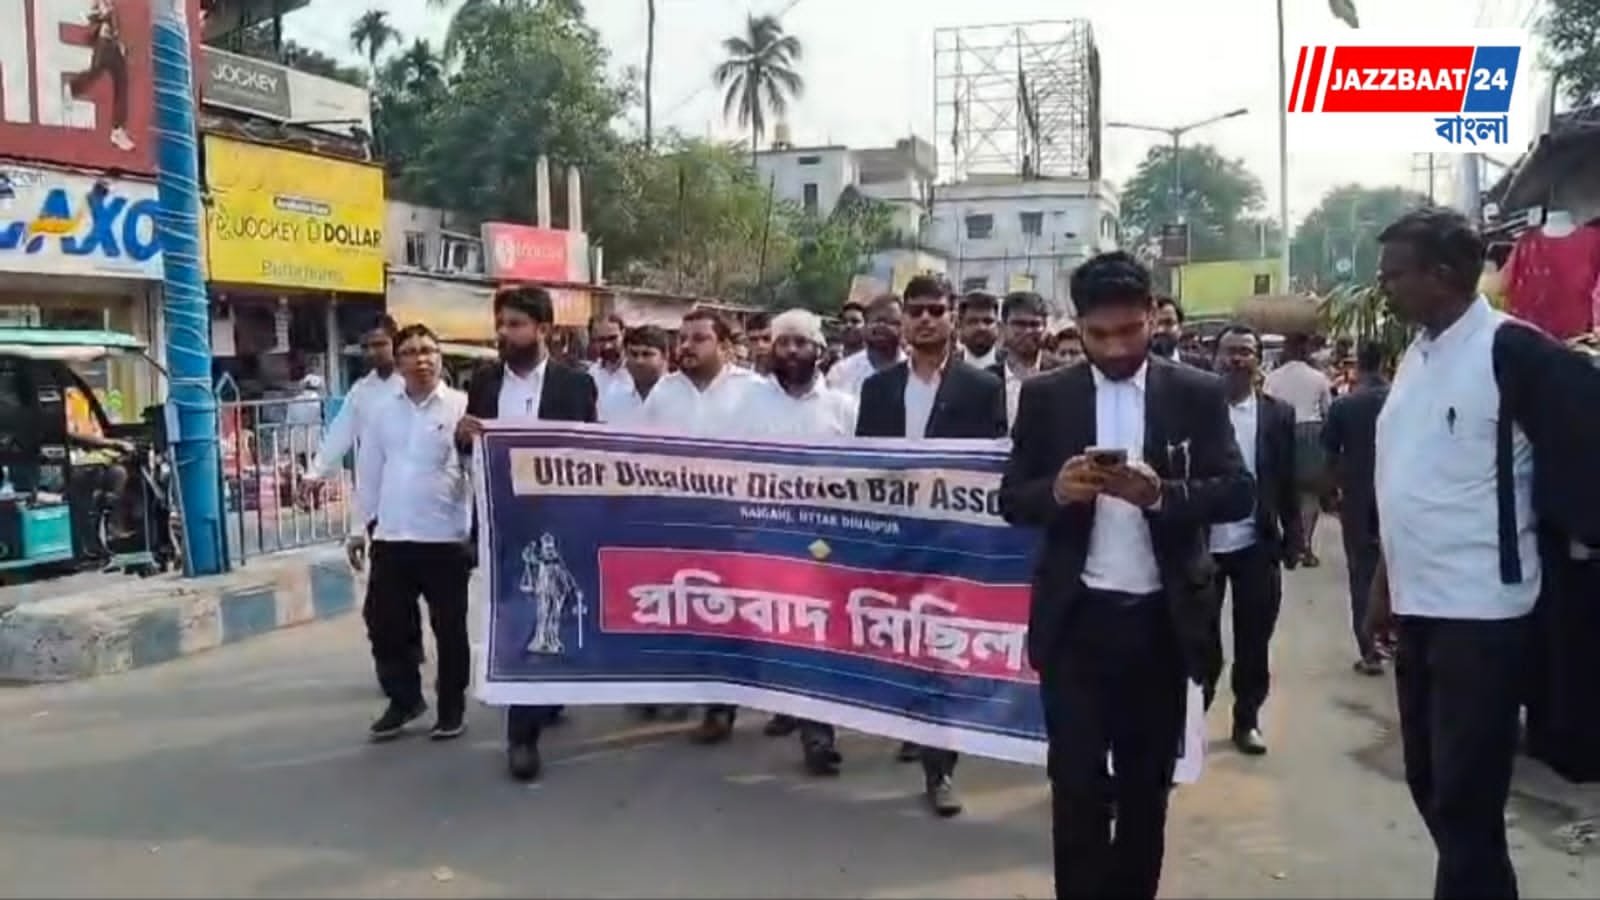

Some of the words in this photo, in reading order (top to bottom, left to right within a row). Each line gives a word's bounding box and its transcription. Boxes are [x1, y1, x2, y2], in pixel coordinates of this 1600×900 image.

[211, 63, 278, 93] JOCKEY
[233, 215, 299, 242] JOCKEY
[324, 222, 381, 248] DOLLAR
[748, 472, 857, 501] District
[865, 477, 920, 507] Bar
[628, 569, 831, 641] প্রতিবাদ
[847, 588, 1028, 671] মিছিল
